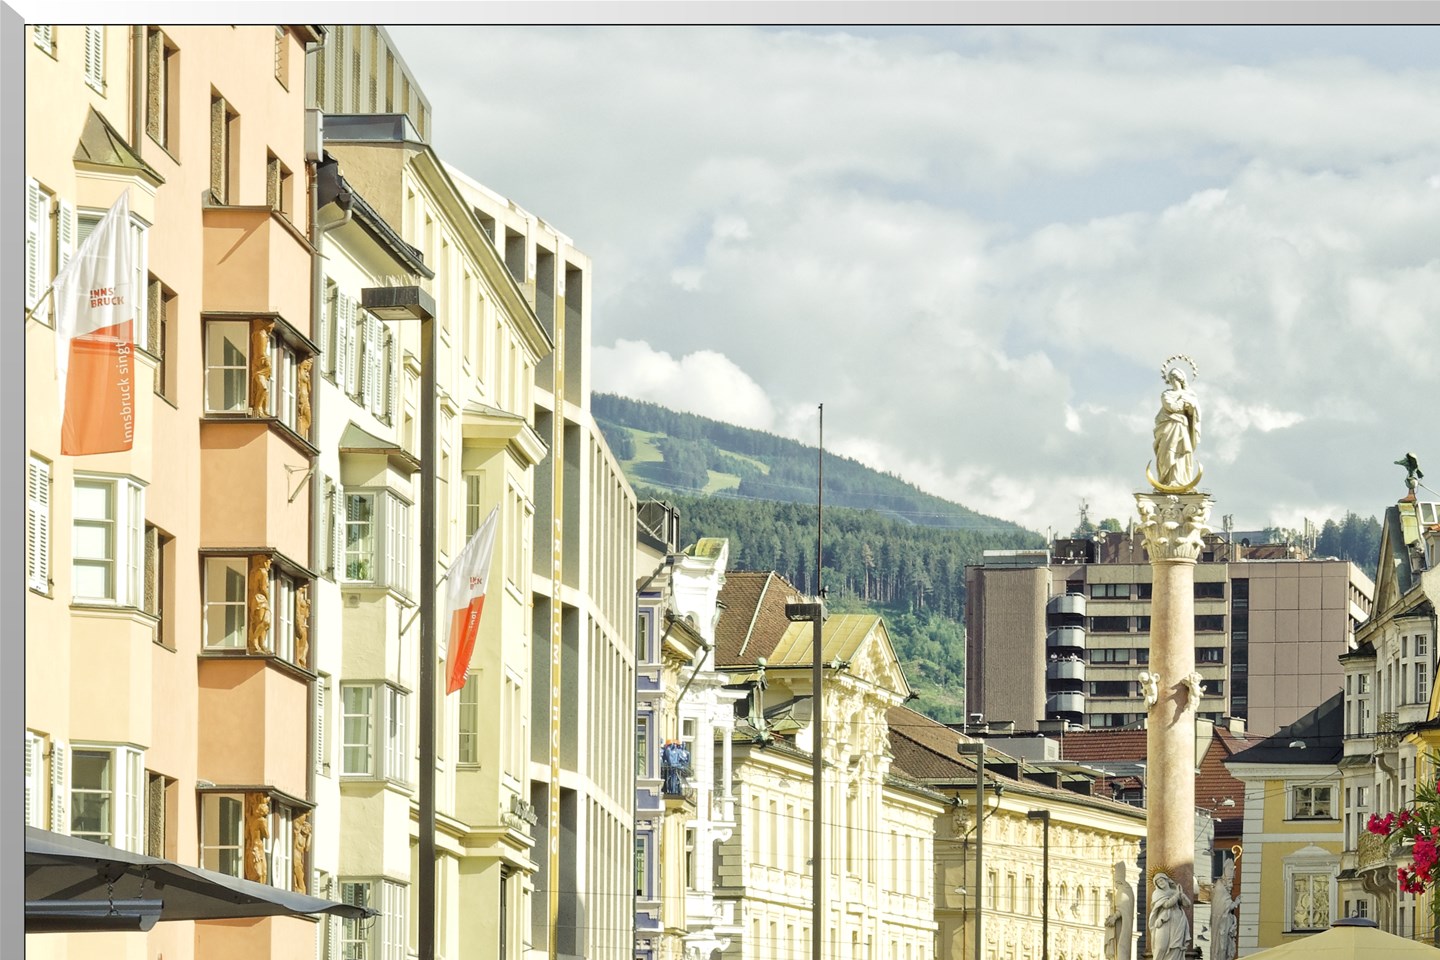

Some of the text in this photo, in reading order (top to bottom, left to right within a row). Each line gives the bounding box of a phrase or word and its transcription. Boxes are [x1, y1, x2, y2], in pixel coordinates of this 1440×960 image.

[91, 296, 124, 308] BRUCK
[116, 341, 132, 443] Innsbruck singt
